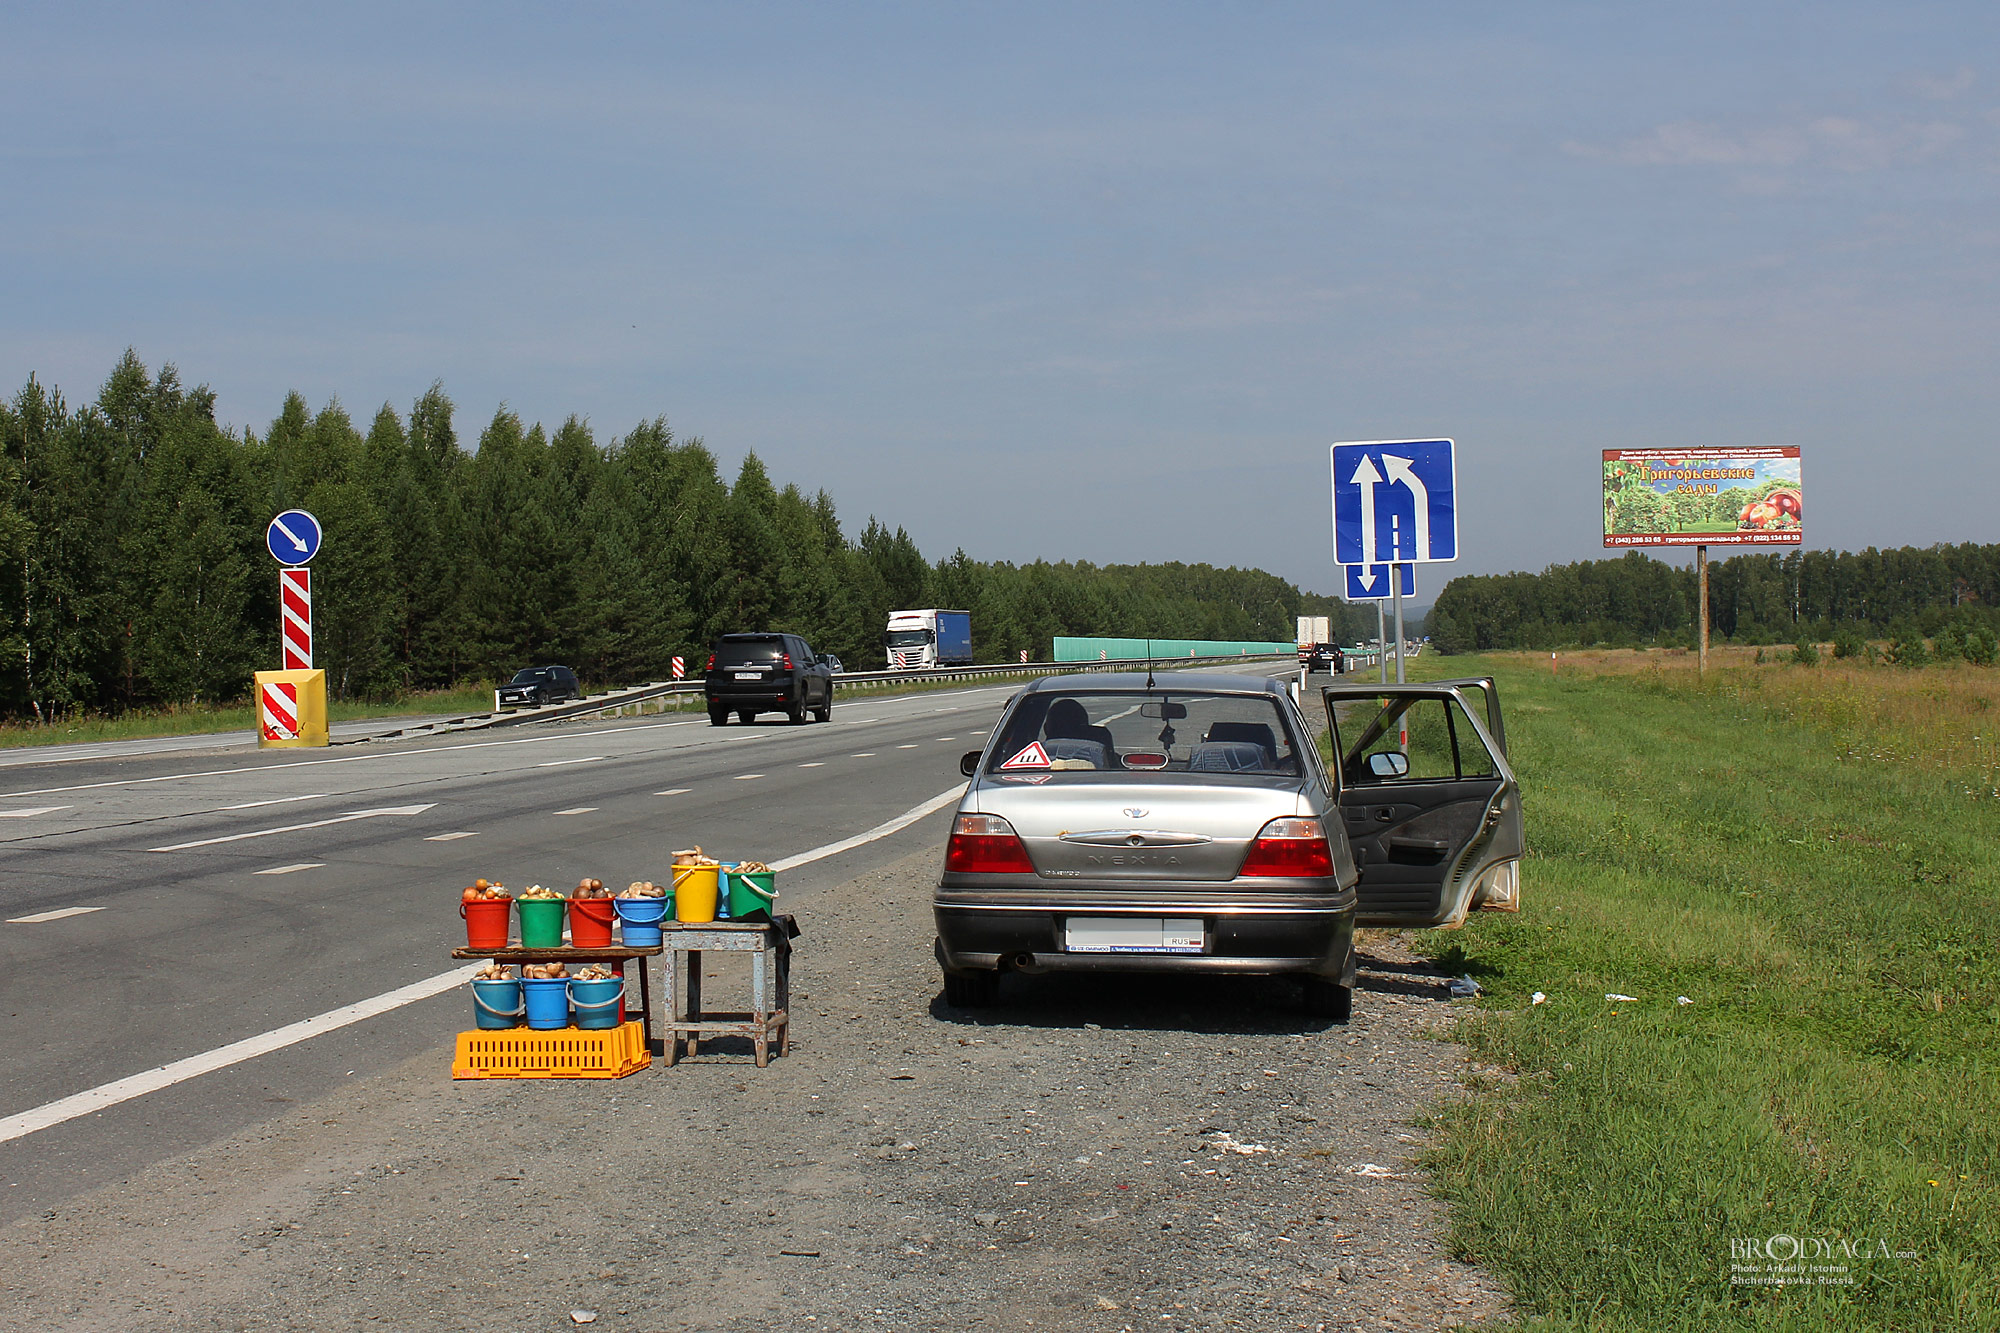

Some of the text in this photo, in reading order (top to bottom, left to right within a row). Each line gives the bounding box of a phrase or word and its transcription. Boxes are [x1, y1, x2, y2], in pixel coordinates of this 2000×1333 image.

[1640, 466, 1755, 484] Григорьевские
[1677, 484, 1717, 496] сады
[1088, 855, 1182, 865] NEXIA
